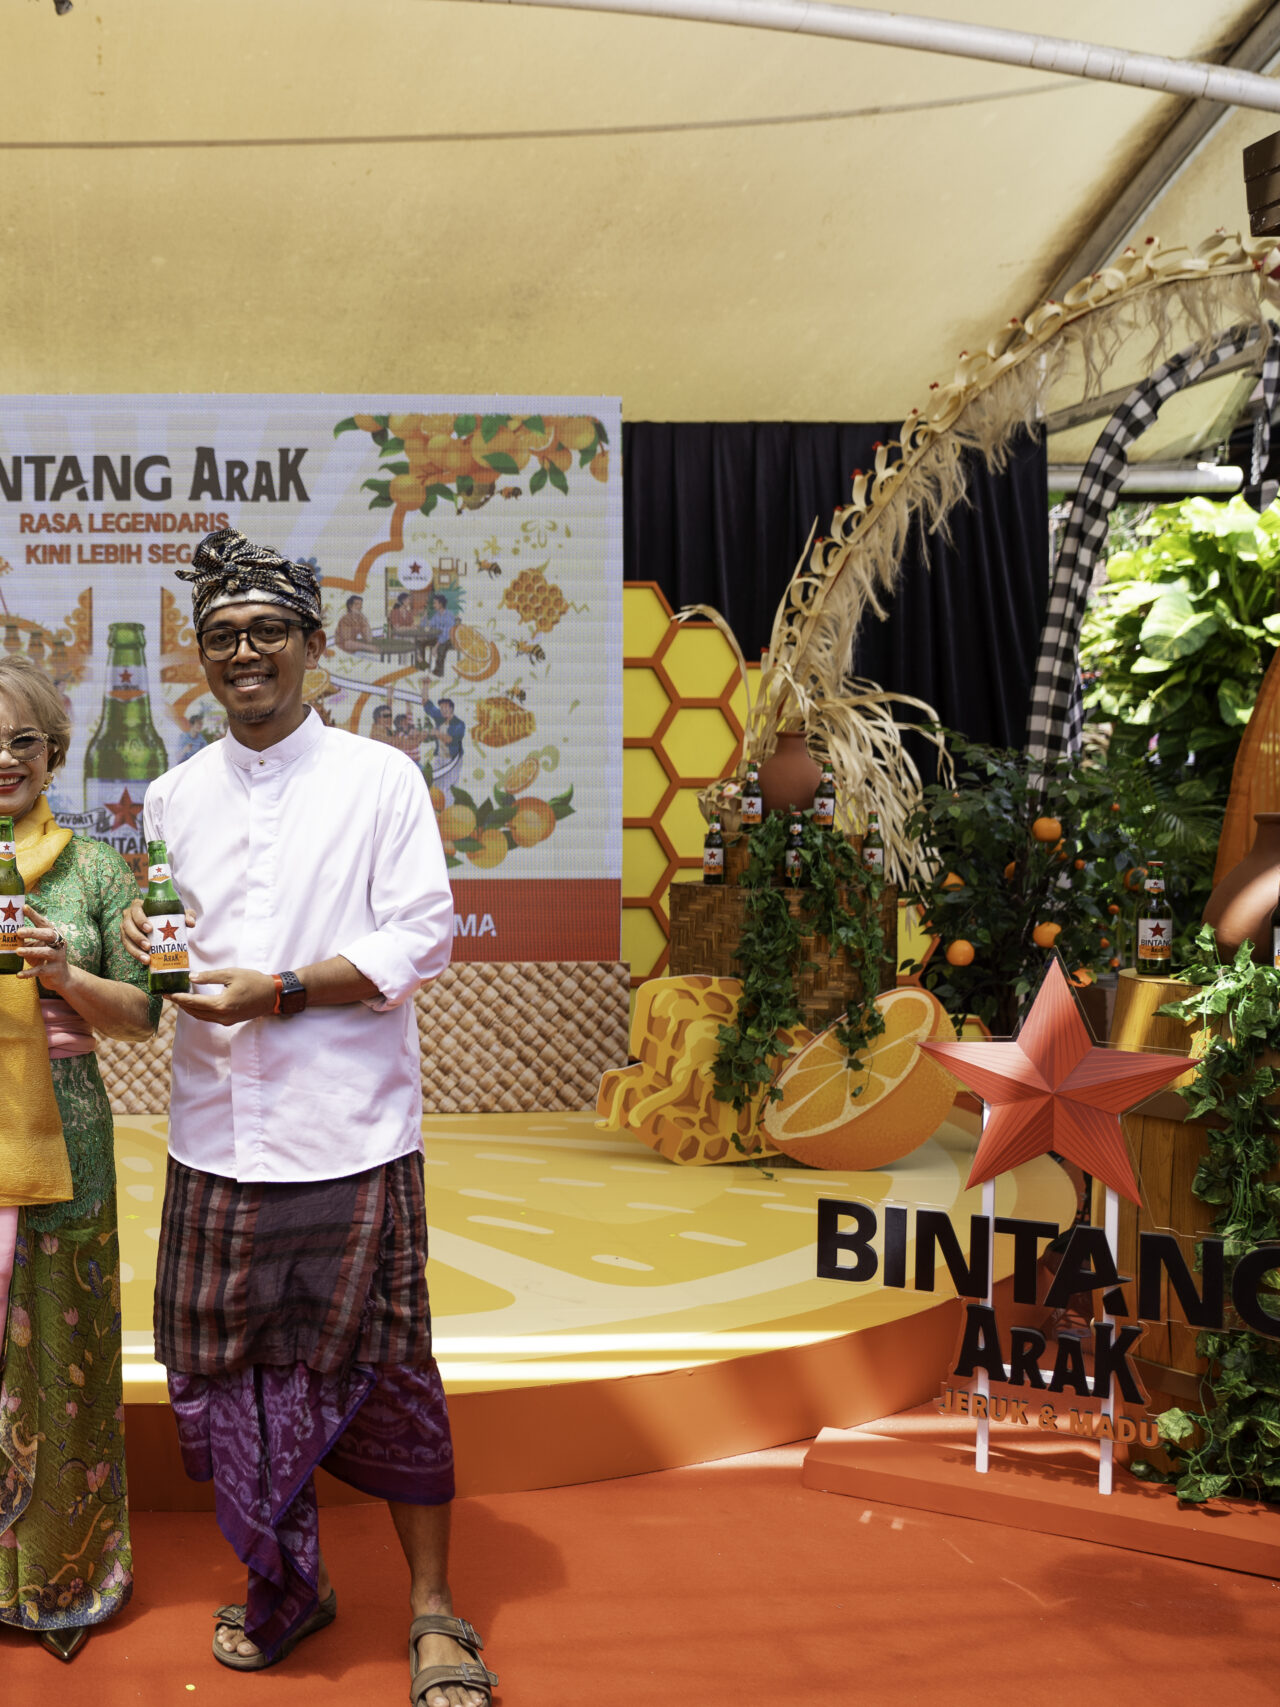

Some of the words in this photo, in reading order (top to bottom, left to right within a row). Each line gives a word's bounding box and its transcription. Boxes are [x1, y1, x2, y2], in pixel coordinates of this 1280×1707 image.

[20, 513, 82, 533] RASA
[88, 513, 229, 534] LEGENDARIS
[26, 544, 70, 565] KINI
[77, 544, 142, 565] LEBIH
[148, 544, 199, 564] SEG
[453, 913, 496, 937] MA
[938, 1388, 1029, 1426] JERUK
[1038, 1403, 1058, 1431] &
[1070, 1408, 1159, 1448] MADU
